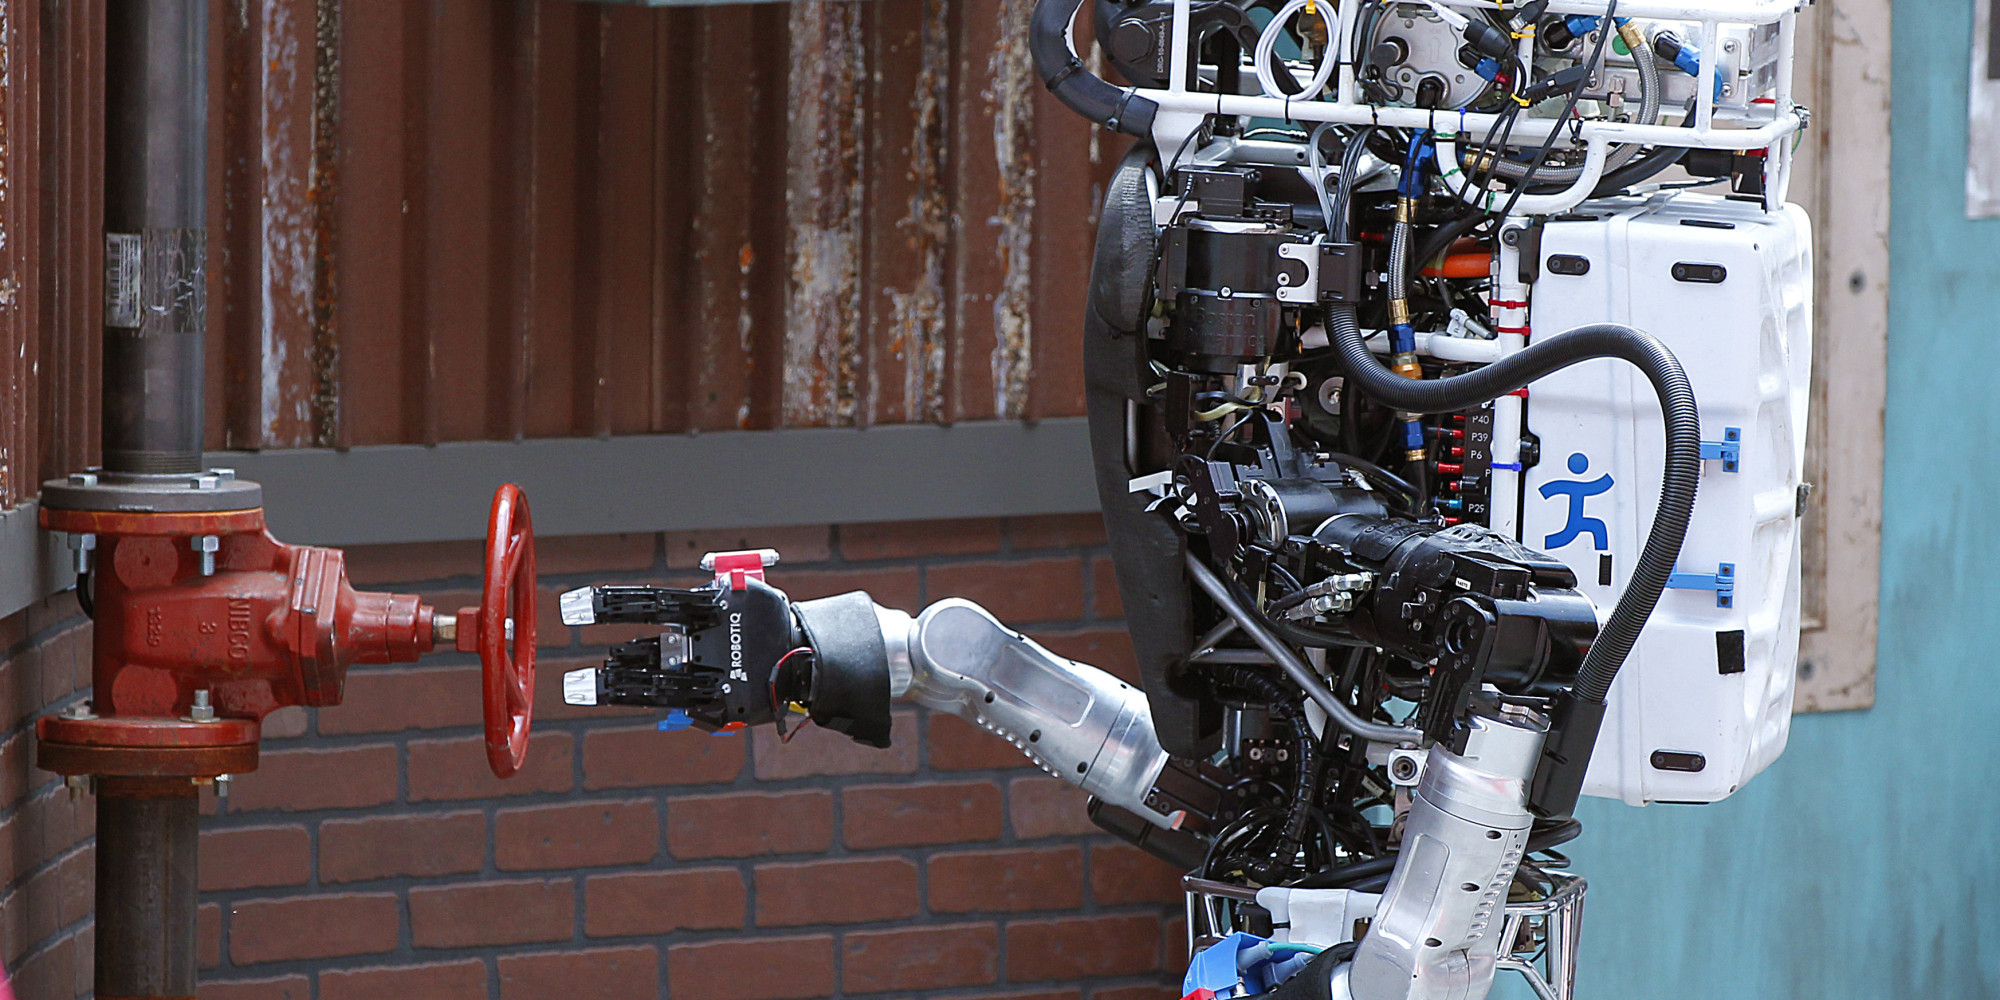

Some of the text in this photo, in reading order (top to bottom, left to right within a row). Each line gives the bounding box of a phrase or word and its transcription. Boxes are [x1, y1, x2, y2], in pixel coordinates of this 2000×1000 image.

[1472, 415, 1489, 425] P40
[1471, 432, 1489, 442] P39
[1470, 450, 1483, 460] P6
[1468, 503, 1485, 513] P29
[199, 622, 217, 635] 3
[227, 597, 251, 658] NIBCO
[730, 613, 742, 667] ROBOTIQ
